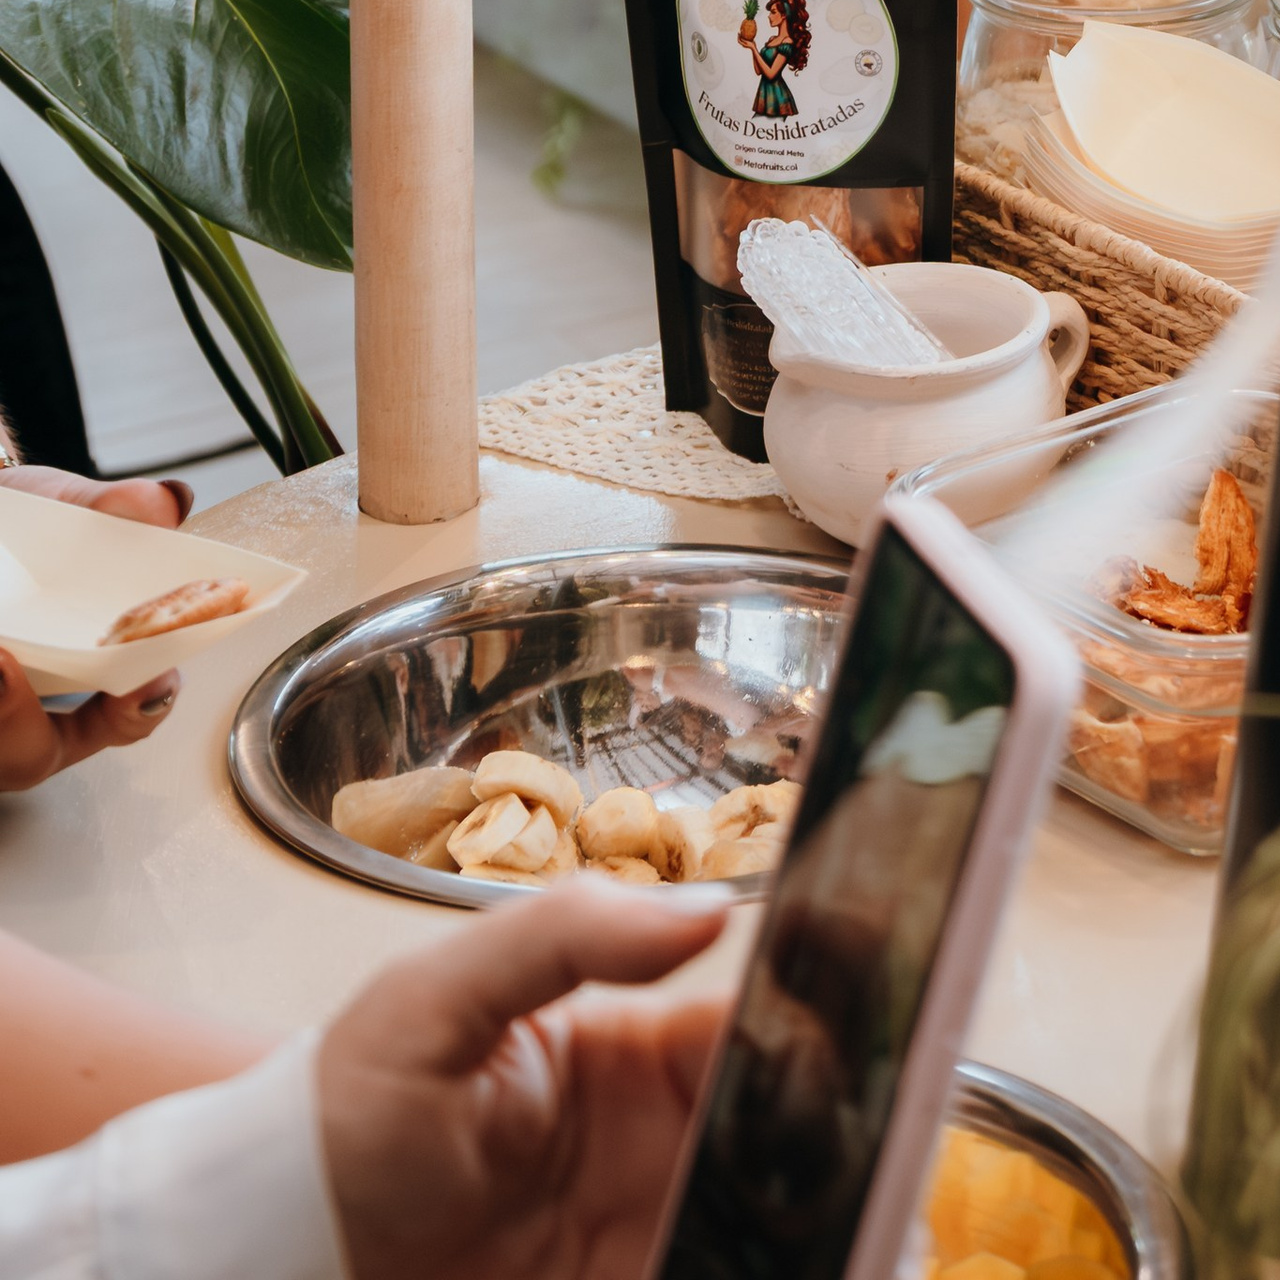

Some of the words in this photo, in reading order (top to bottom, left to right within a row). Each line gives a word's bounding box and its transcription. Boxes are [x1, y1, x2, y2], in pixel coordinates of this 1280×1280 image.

[698, 90, 741, 132] Frutas
[743, 97, 865, 141] Deshidratadas
[734, 143, 757, 154] Origen
[786, 149, 804, 158] Meta
